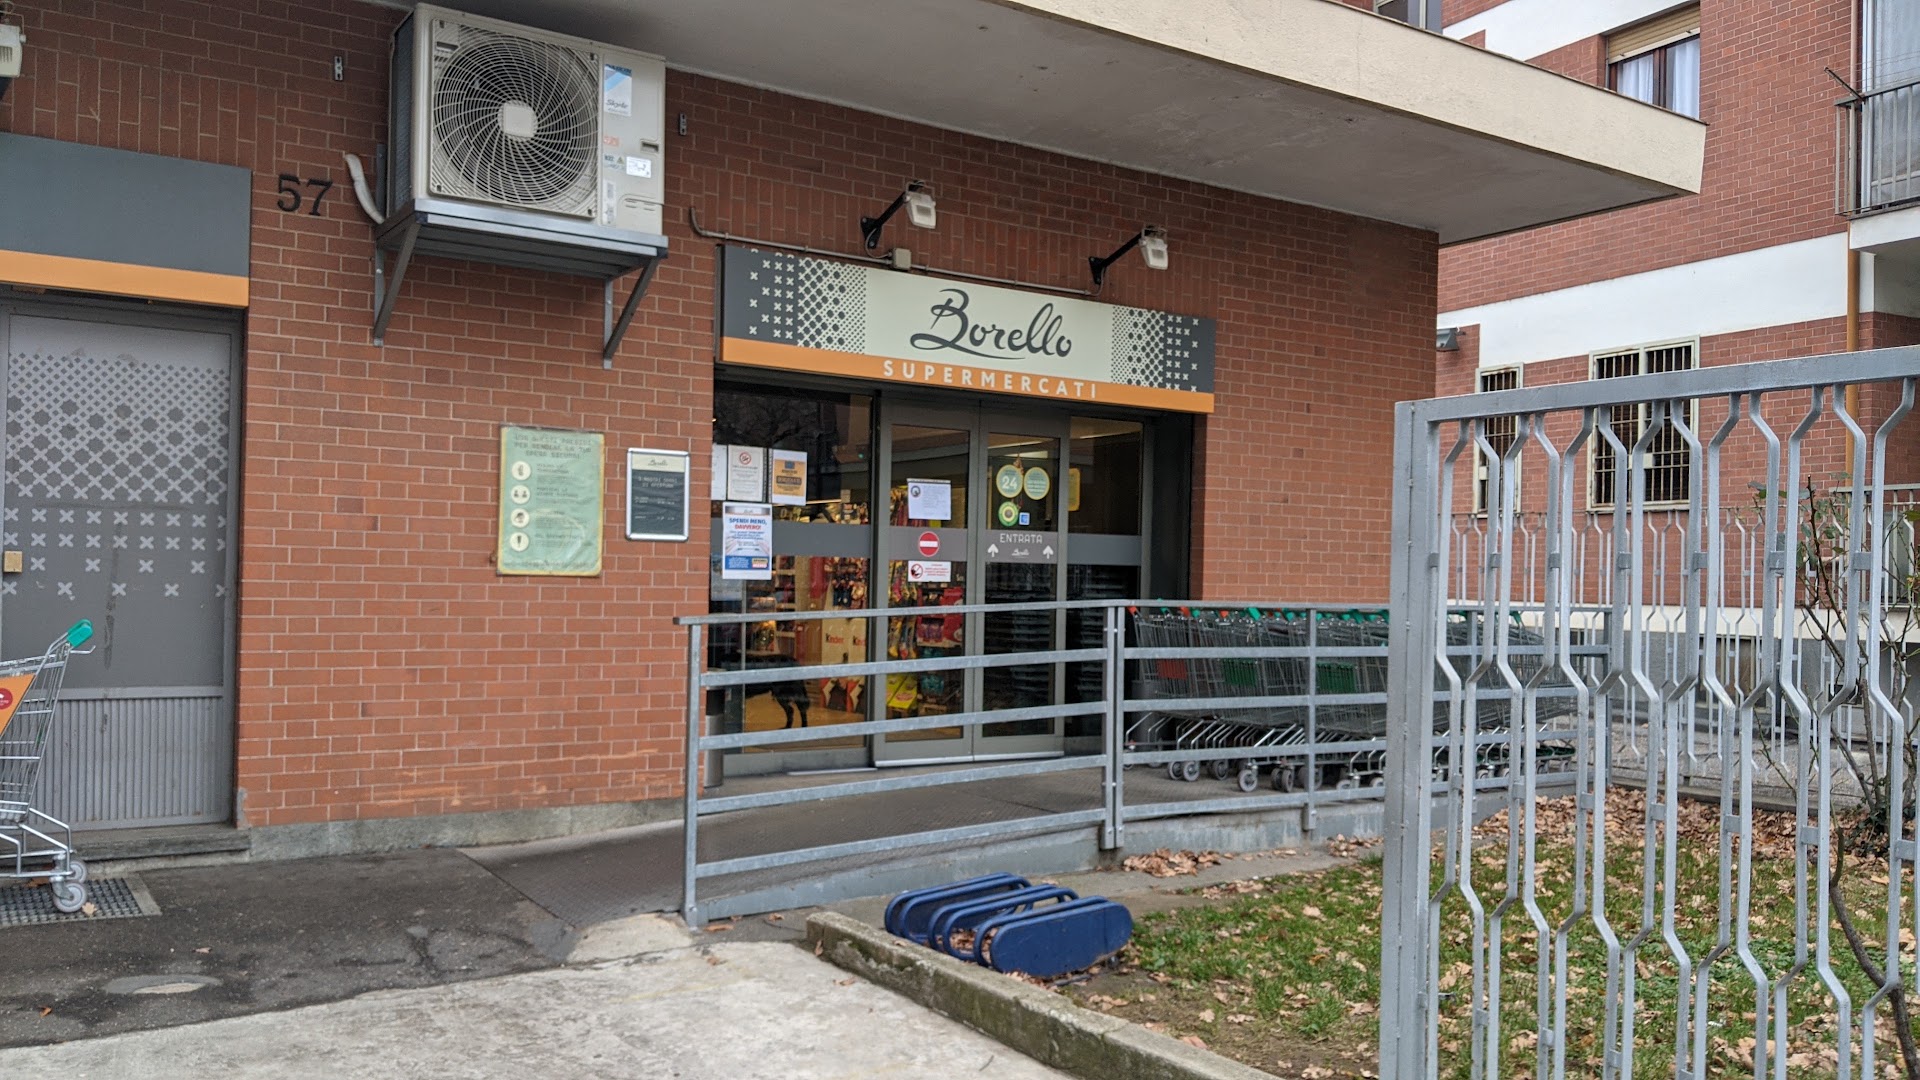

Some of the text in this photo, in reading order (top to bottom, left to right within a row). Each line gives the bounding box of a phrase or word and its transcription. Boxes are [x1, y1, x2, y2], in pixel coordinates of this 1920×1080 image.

[277, 174, 333, 216] 57
[910, 289, 1072, 360] Borello
[883, 360, 1097, 399] SUPERMERCATI
[1001, 475, 1018, 489] 24
[1000, 533, 1043, 544] ENTRATA
